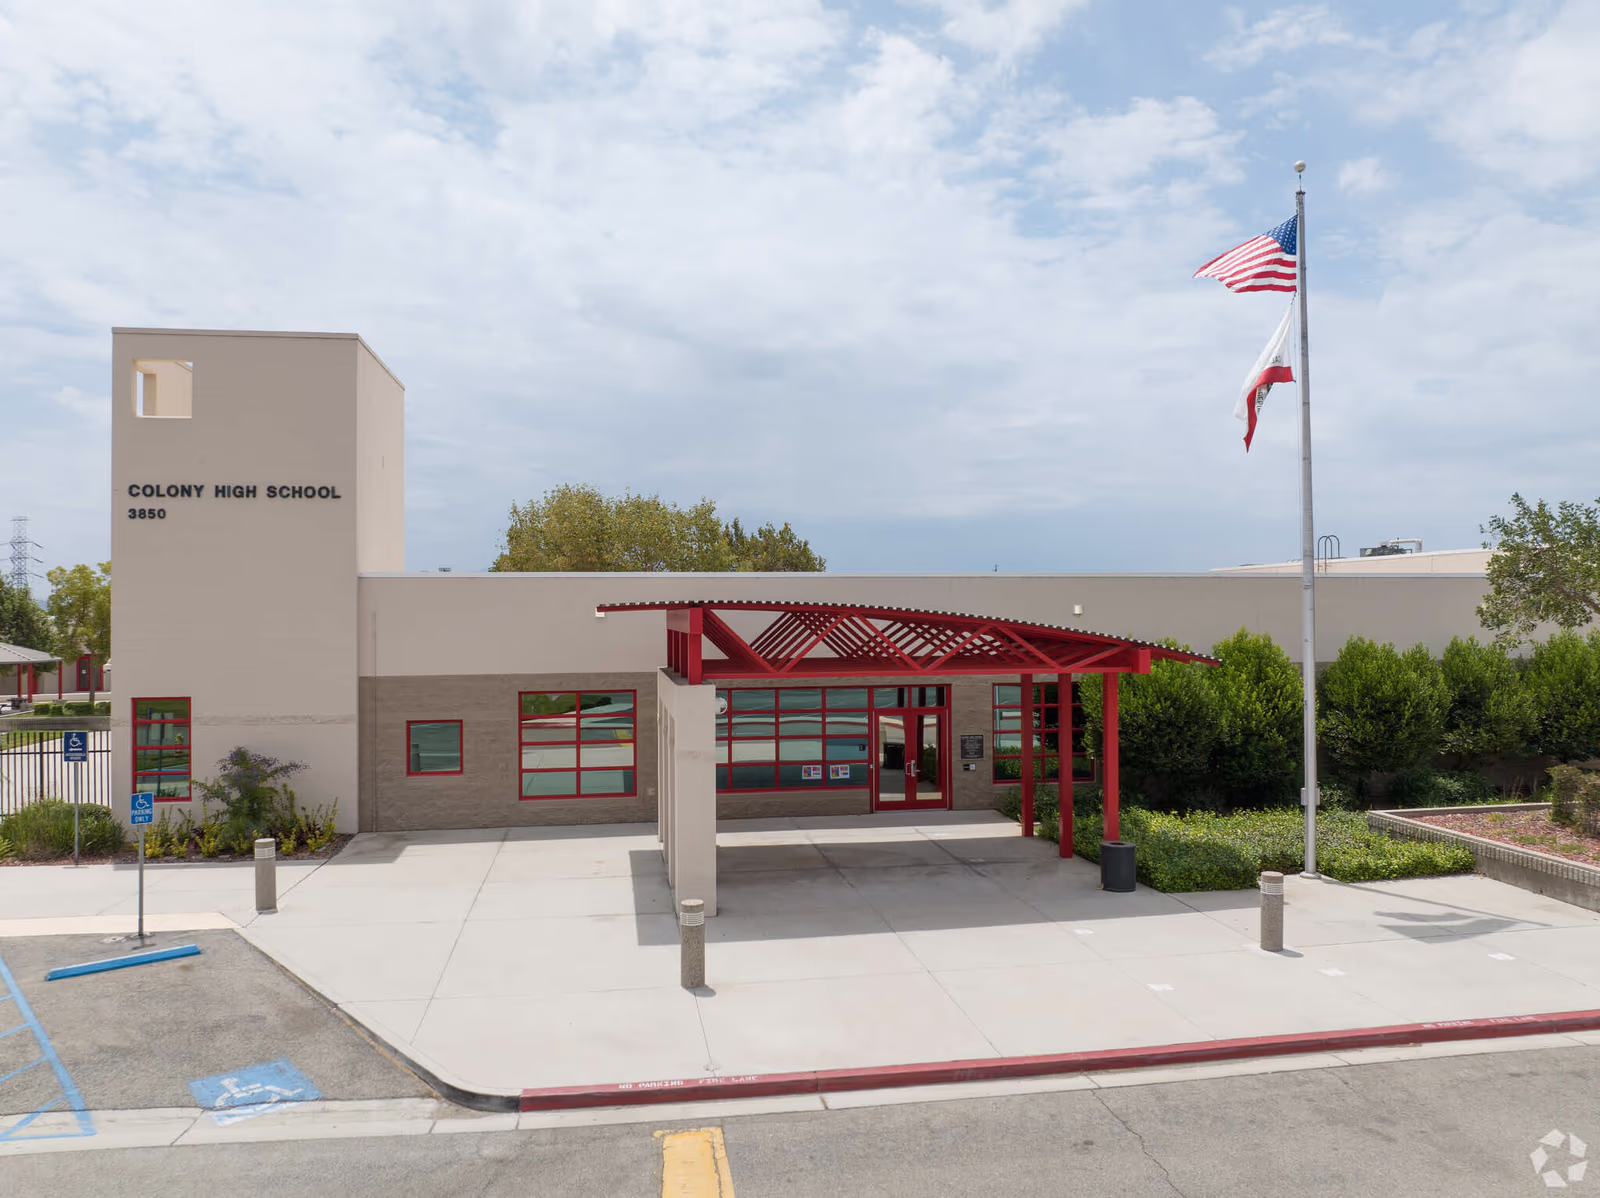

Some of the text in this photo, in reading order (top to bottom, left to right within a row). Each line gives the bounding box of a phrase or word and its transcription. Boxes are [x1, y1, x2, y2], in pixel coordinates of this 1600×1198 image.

[128, 484, 341, 499] COLONY HIGH SCHOOL
[128, 508, 167, 520] 3850
[638, 1080, 684, 1088] PARKING
